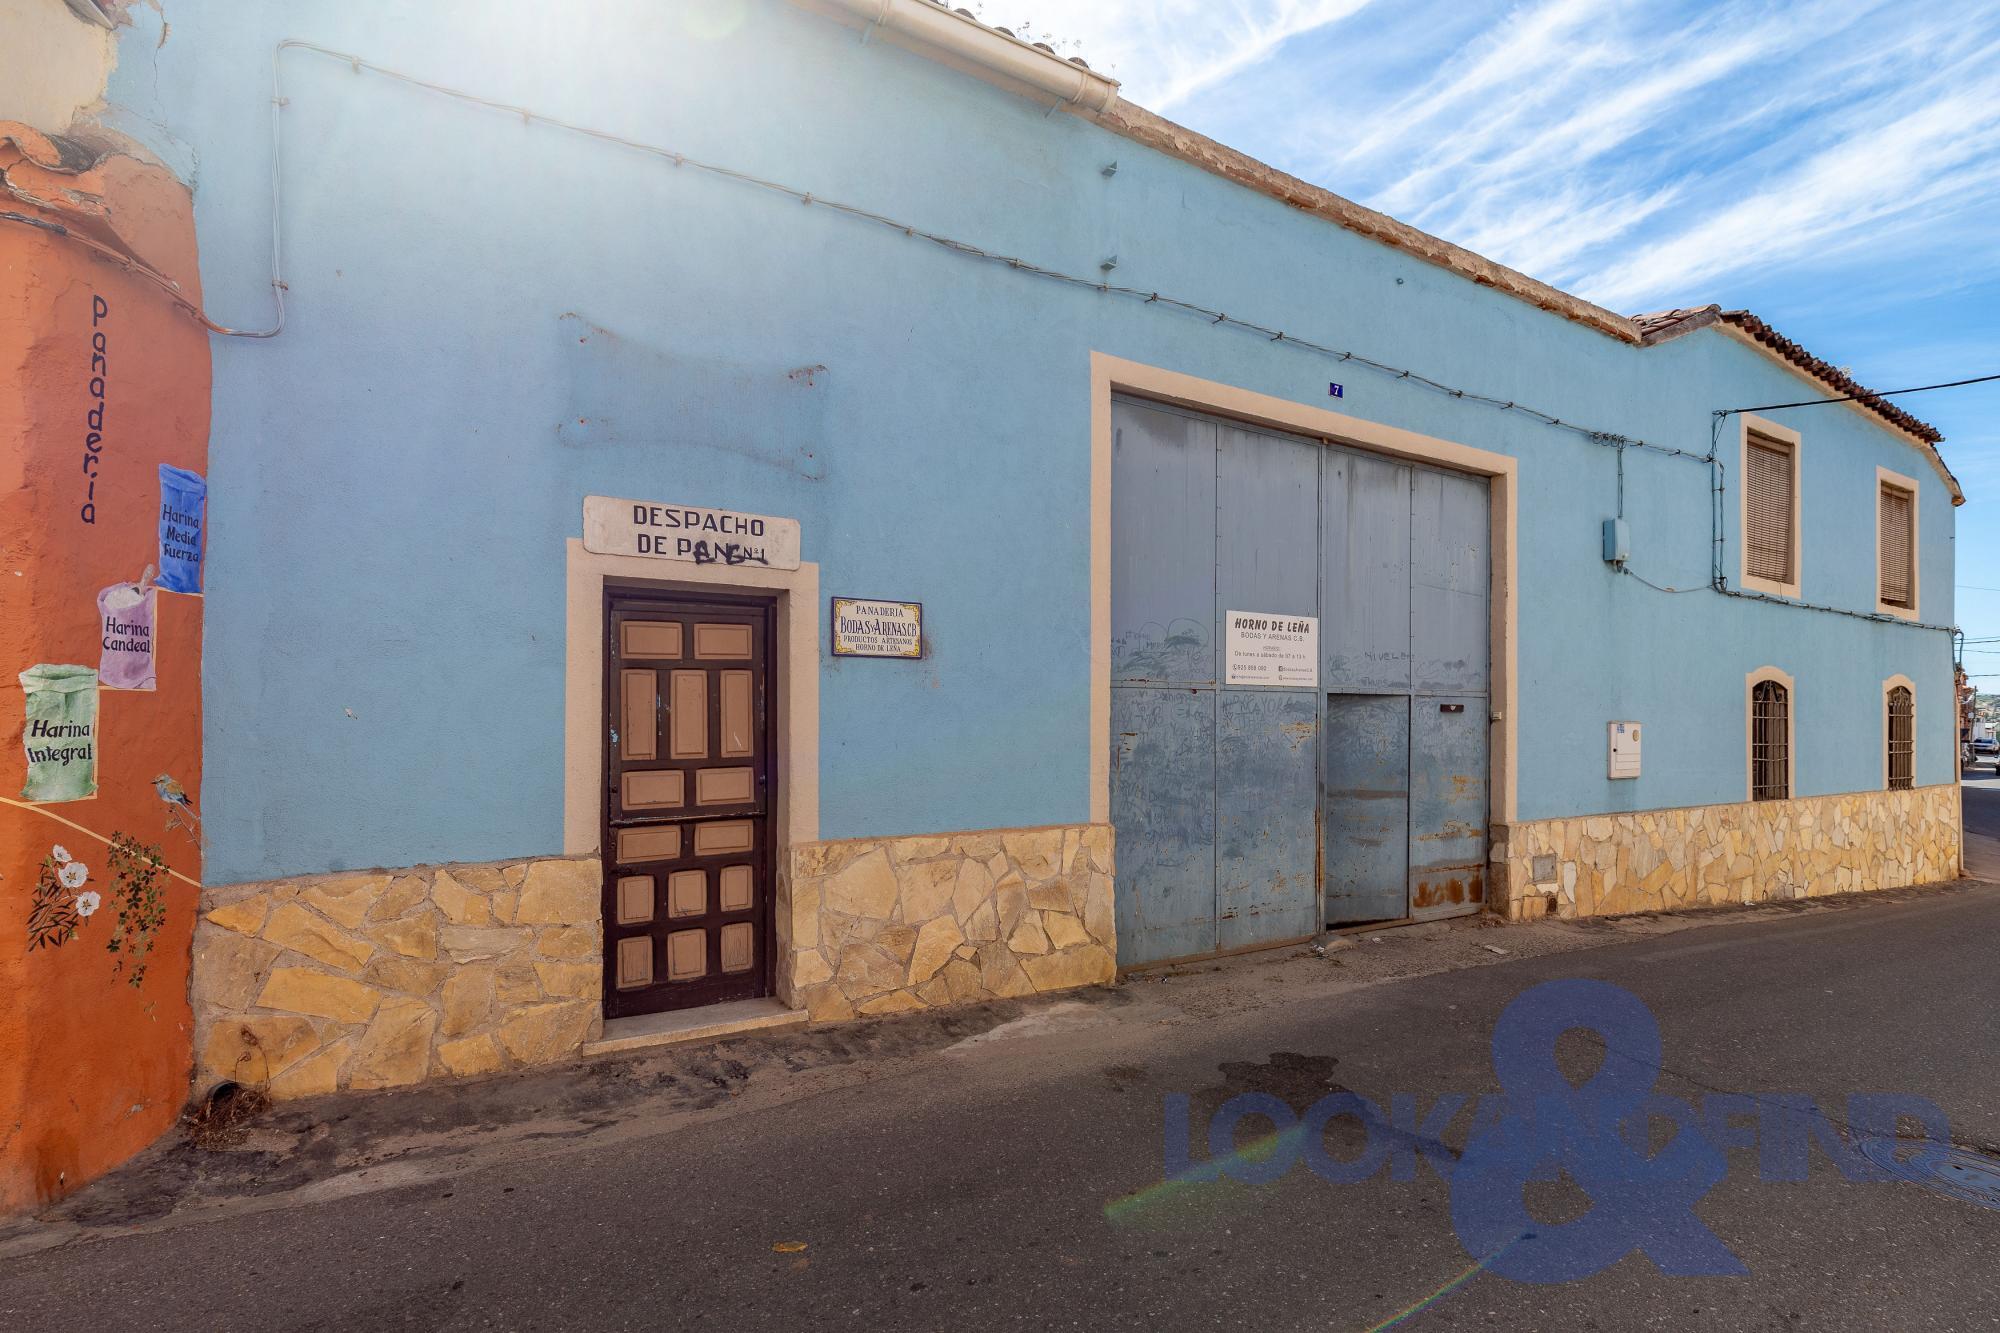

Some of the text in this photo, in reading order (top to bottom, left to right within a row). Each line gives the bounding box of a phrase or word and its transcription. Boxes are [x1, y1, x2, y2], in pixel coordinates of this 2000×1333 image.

[162, 503, 200, 529] Harina
[633, 505, 765, 537] DESPACHO
[166, 525, 197, 546] Media
[163, 543, 199, 562] Fuerza
[638, 533, 667, 556] DE
[677, 537, 729, 560] PAN
[856, 605, 904, 618] PANADERIA
[105, 615, 150, 637] Harina
[840, 615, 871, 635] BODAS
[1234, 617, 1310, 634] HORNO DE LEÑA
[102, 636, 151, 654] Candeal
[843, 634, 913, 646] PRODUCTOS ARTESANOS
[1240, 631, 1262, 640] BODAS
[1268, 633, 1292, 641] ARENAS
[855, 643, 876, 651] HORNO
[877, 644, 885, 652] DE
[31, 719, 90, 738] Harina
[27, 743, 93, 767] Integral
